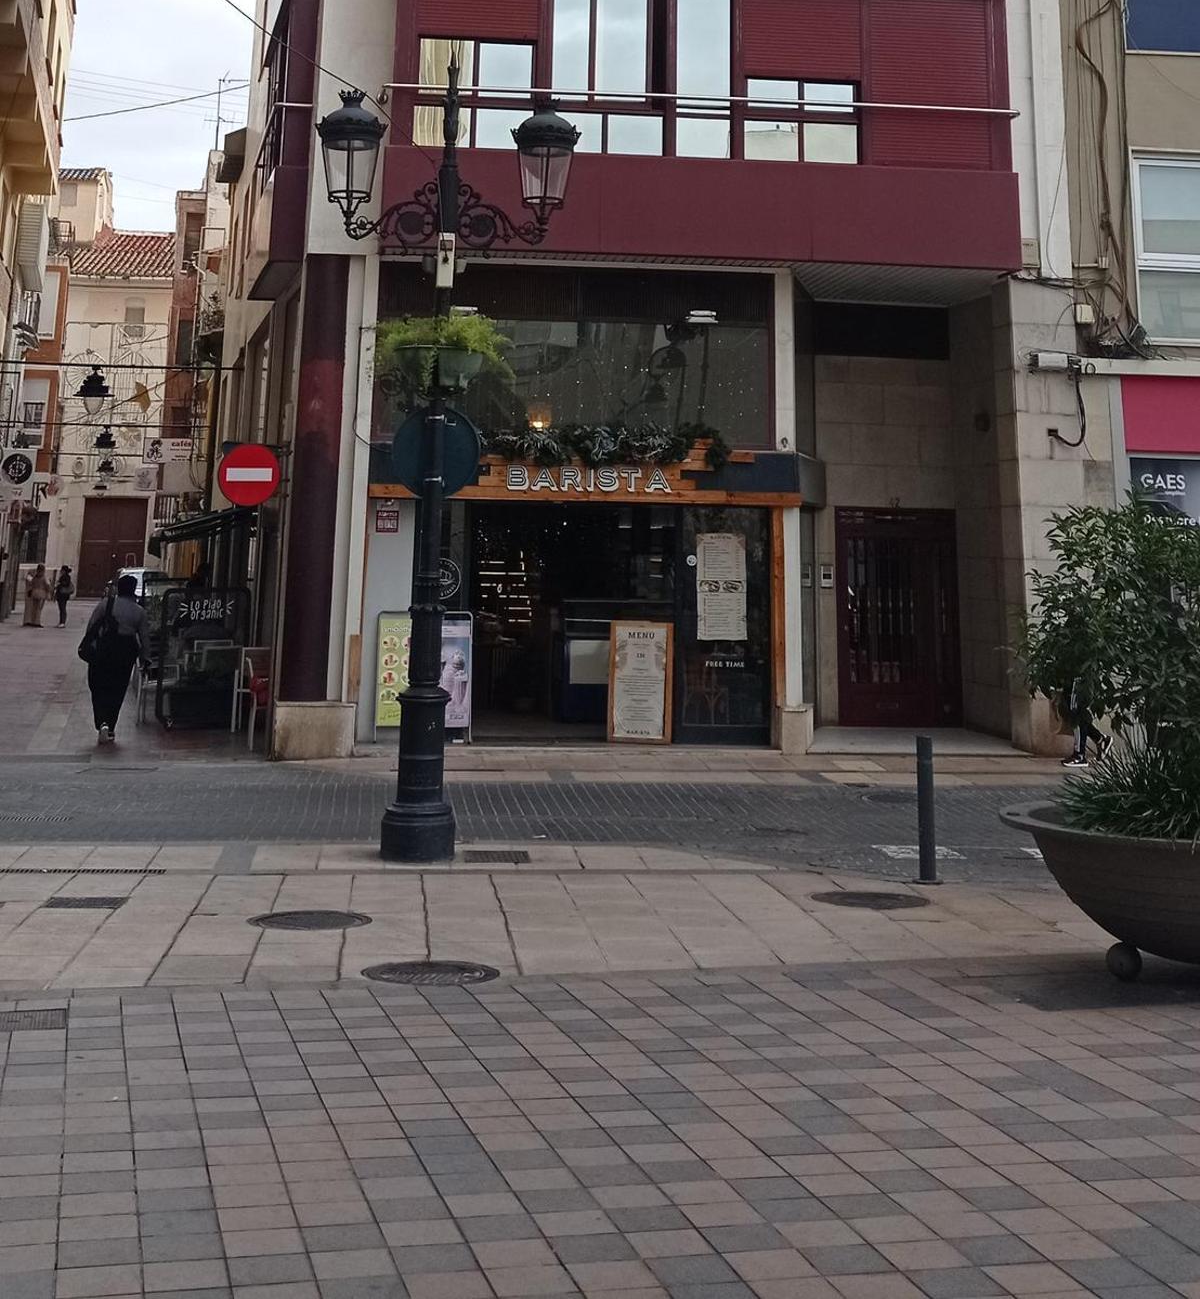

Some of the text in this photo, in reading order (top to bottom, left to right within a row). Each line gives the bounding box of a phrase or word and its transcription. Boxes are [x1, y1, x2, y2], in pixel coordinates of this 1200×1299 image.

[506, 464, 672, 493] BARISTA
[1140, 473, 1187, 490] GAES
[705, 660, 745, 668] FREE TIME
